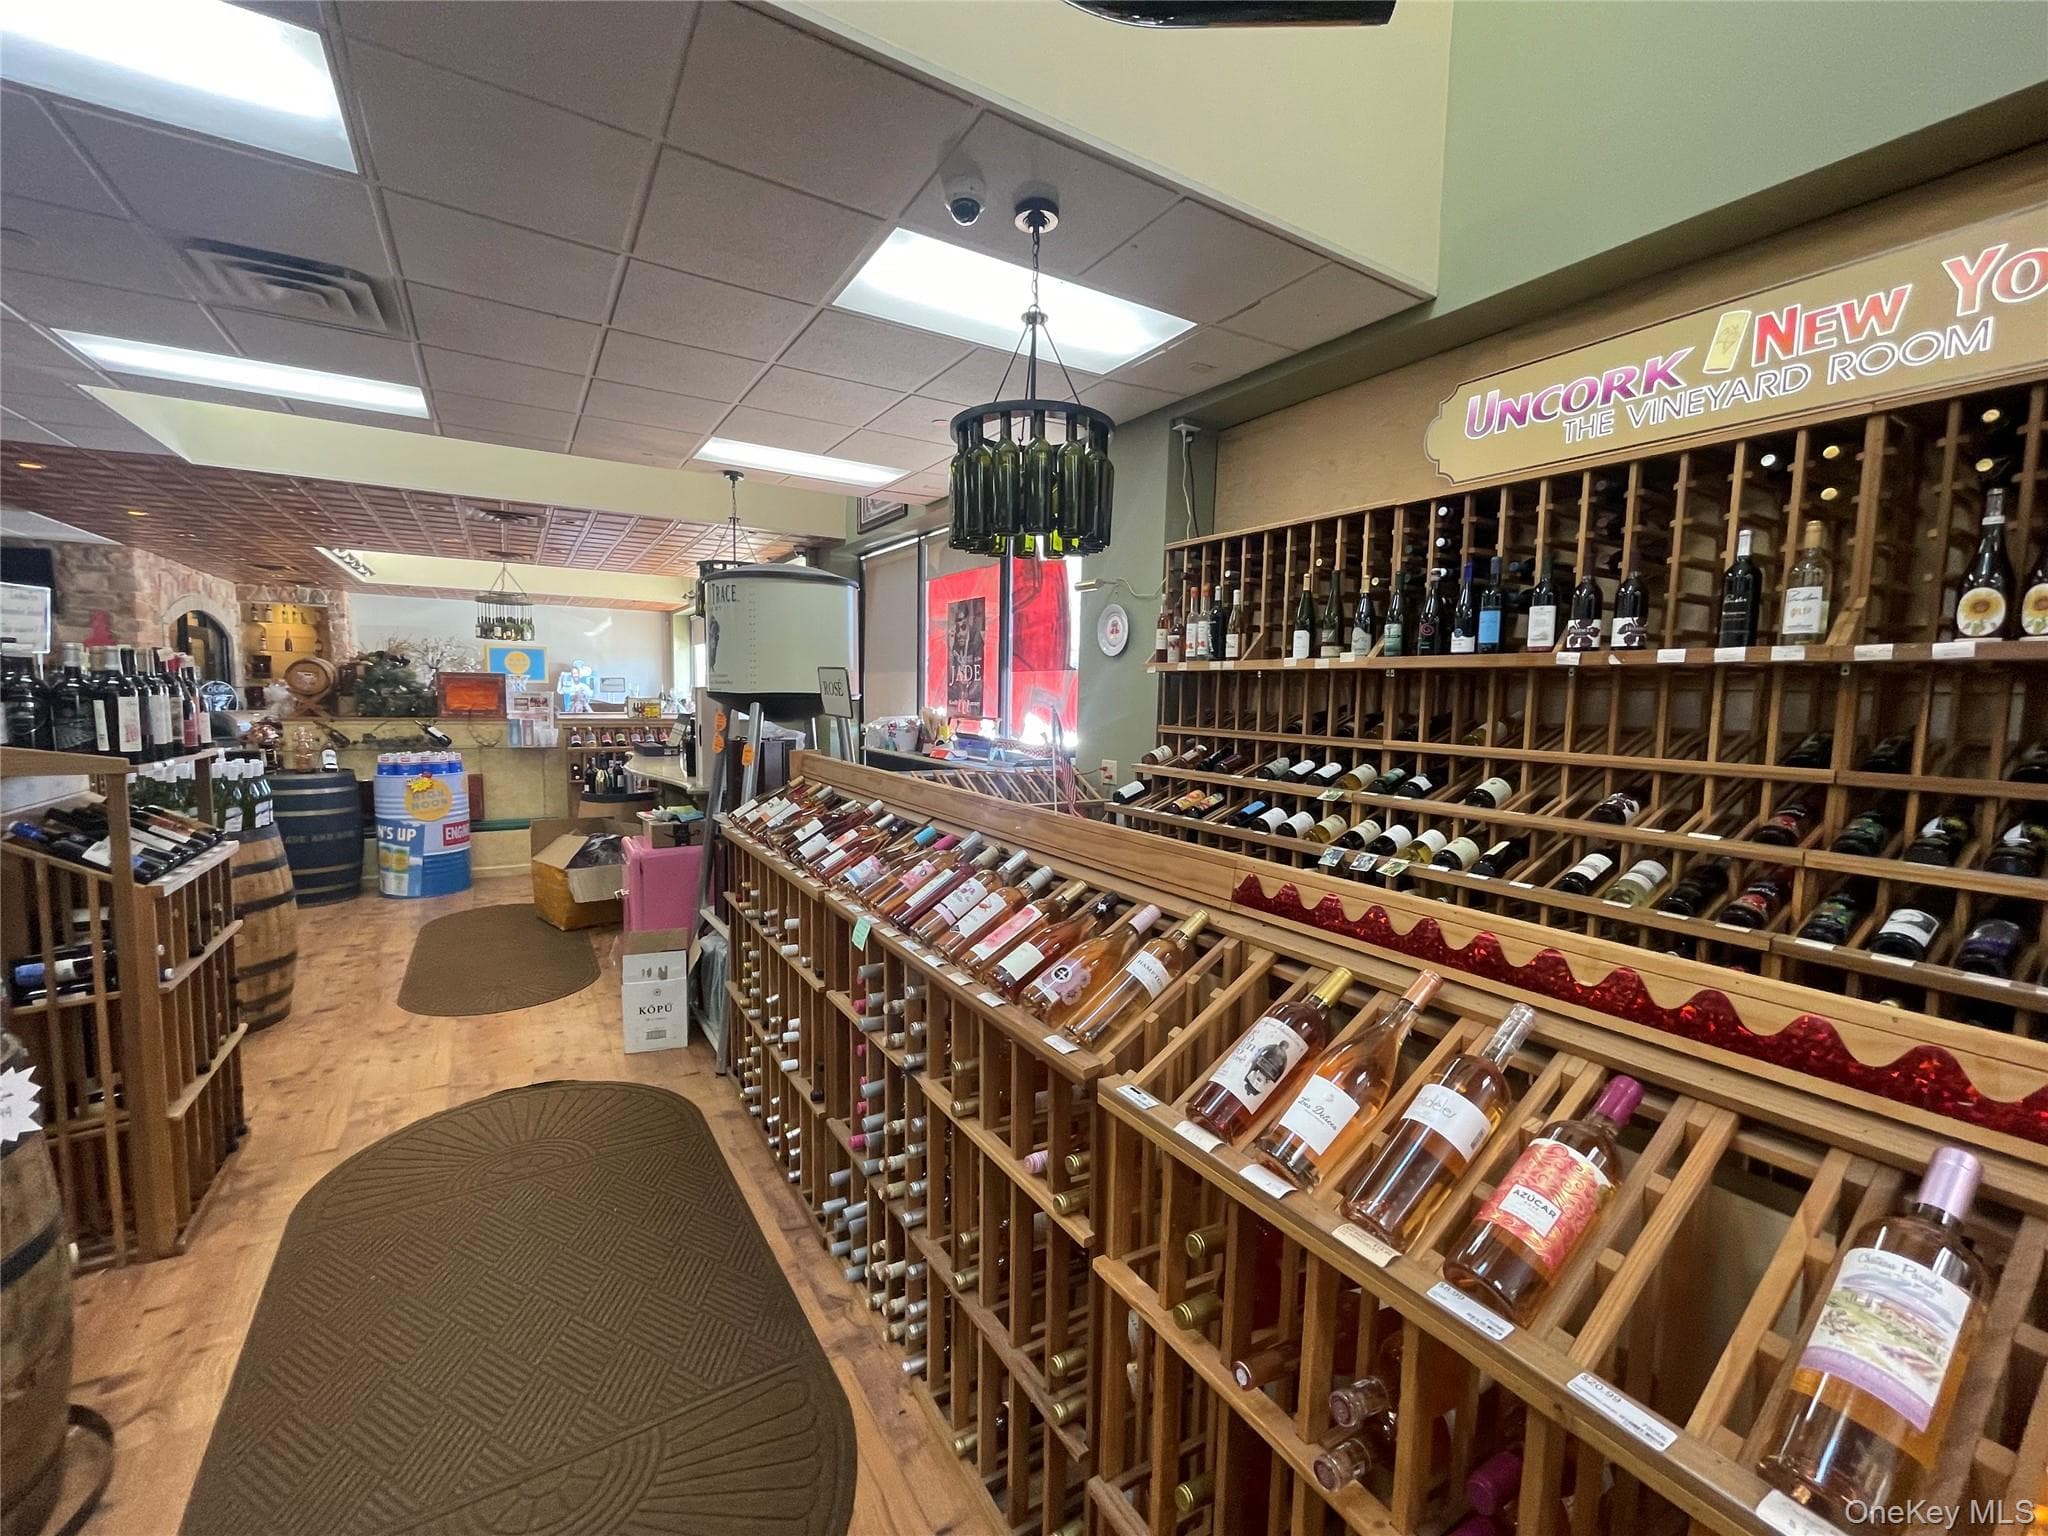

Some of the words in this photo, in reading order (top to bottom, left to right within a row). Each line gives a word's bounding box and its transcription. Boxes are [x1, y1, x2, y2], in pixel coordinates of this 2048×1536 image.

[1464, 346, 1697, 440] UNCORK
[1751, 284, 1913, 367] NEW
[1563, 409, 1616, 443] THE
[1626, 362, 1812, 430] VINEYARD
[1827, 316, 1994, 385] ROOM
[711, 584, 737, 605] TRACE
[949, 665, 982, 687] JADE
[397, 827, 417, 842] UP
